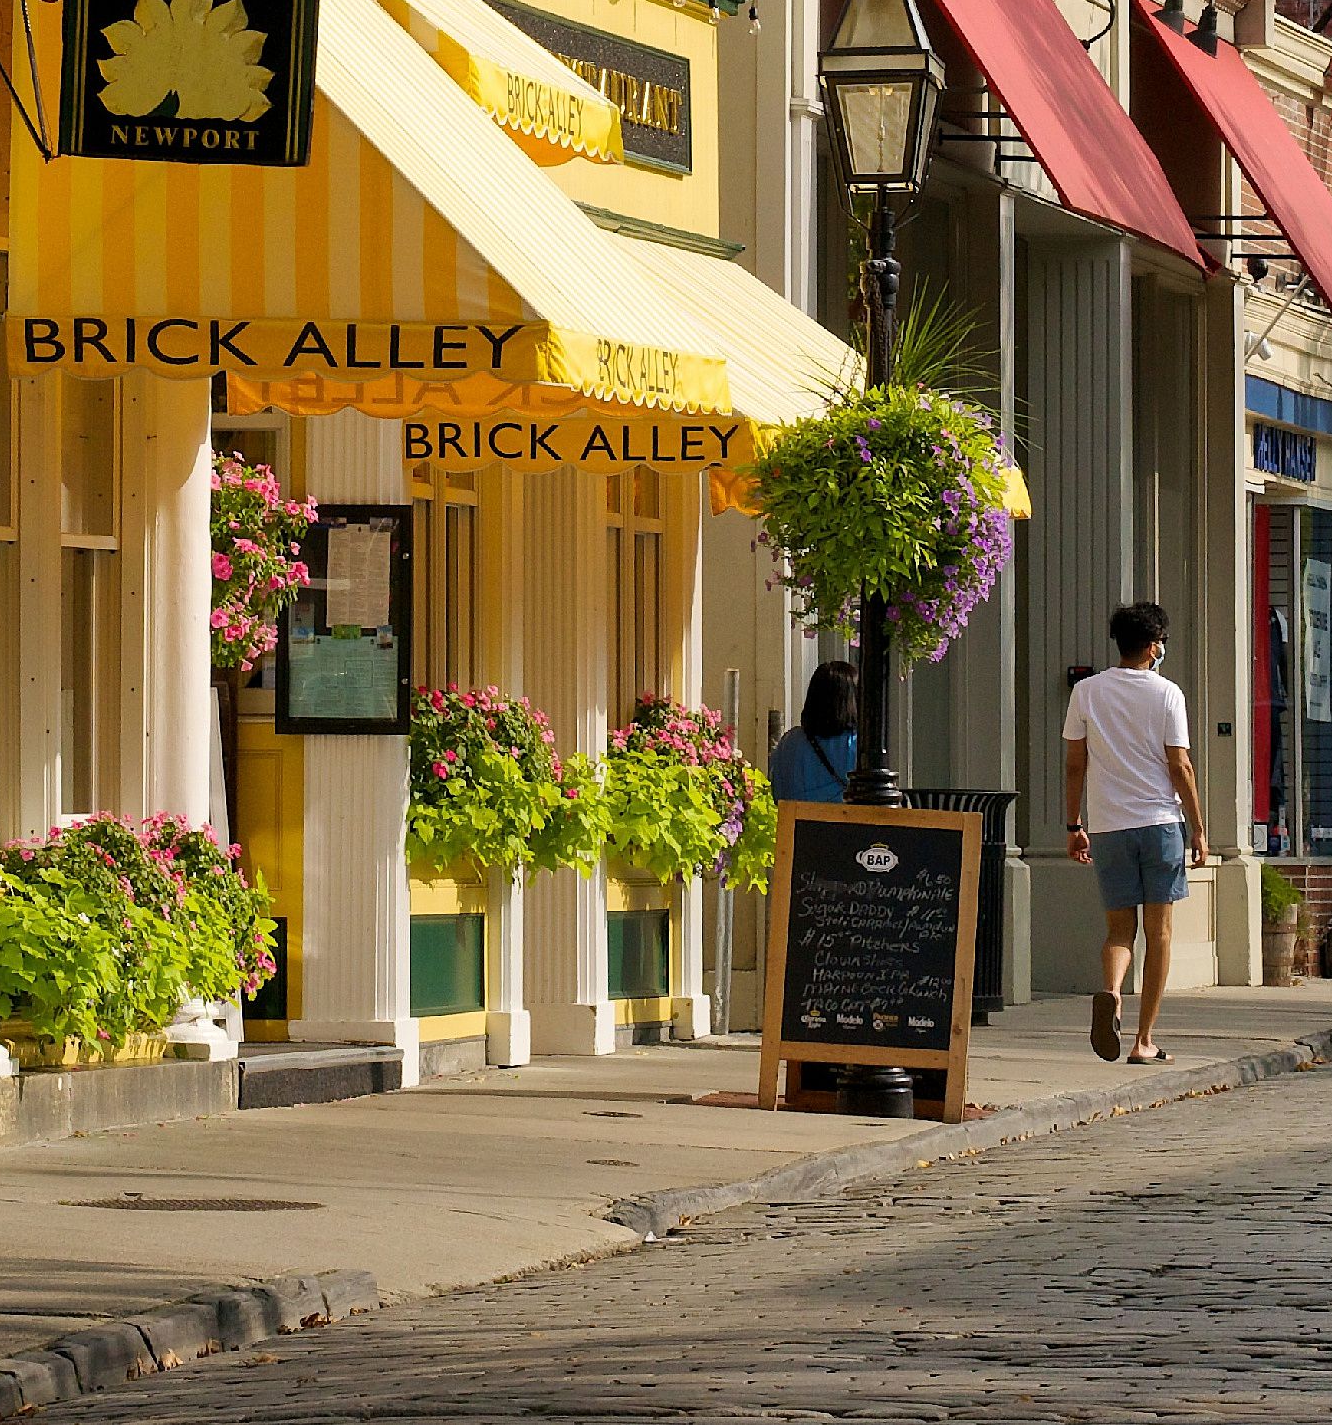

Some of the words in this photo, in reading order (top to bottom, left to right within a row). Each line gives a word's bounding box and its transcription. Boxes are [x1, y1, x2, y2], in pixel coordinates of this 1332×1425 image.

[506, 71, 544, 125] BRICK
[547, 86, 584, 139] ALLEY
[110, 124, 261, 151] NEWPORT
[23, 317, 259, 367] BRICK
[282, 321, 526, 370] ALLEY
[596, 337, 637, 391] BRICK
[639, 347, 679, 395] ALLEY
[405, 422, 563, 461] BRICK
[579, 423, 740, 463] ALLEY
[866, 854, 891, 866] BAP
[836, 1013, 865, 1026] Modelo
